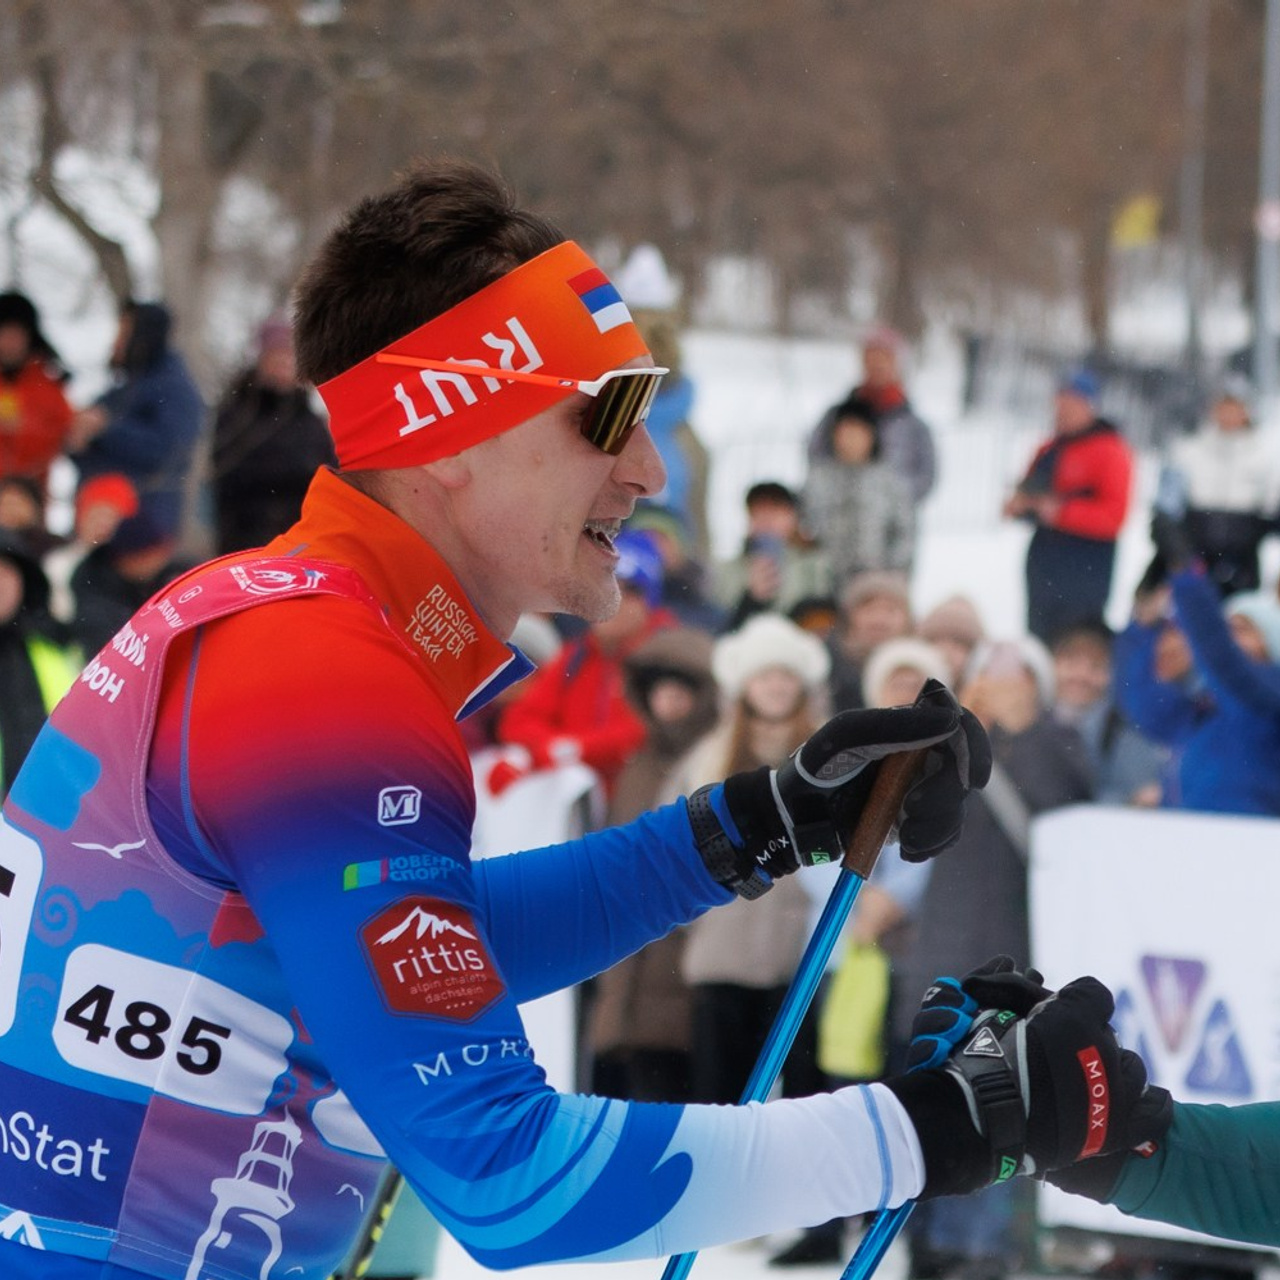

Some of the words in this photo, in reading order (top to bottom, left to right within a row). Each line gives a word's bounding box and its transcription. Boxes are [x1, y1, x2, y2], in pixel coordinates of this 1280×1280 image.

[756, 836, 790, 865] MOX
[393, 942, 485, 983] rittis
[63, 984, 231, 1077] 485
[1086, 1060, 1105, 1130] MOAX
